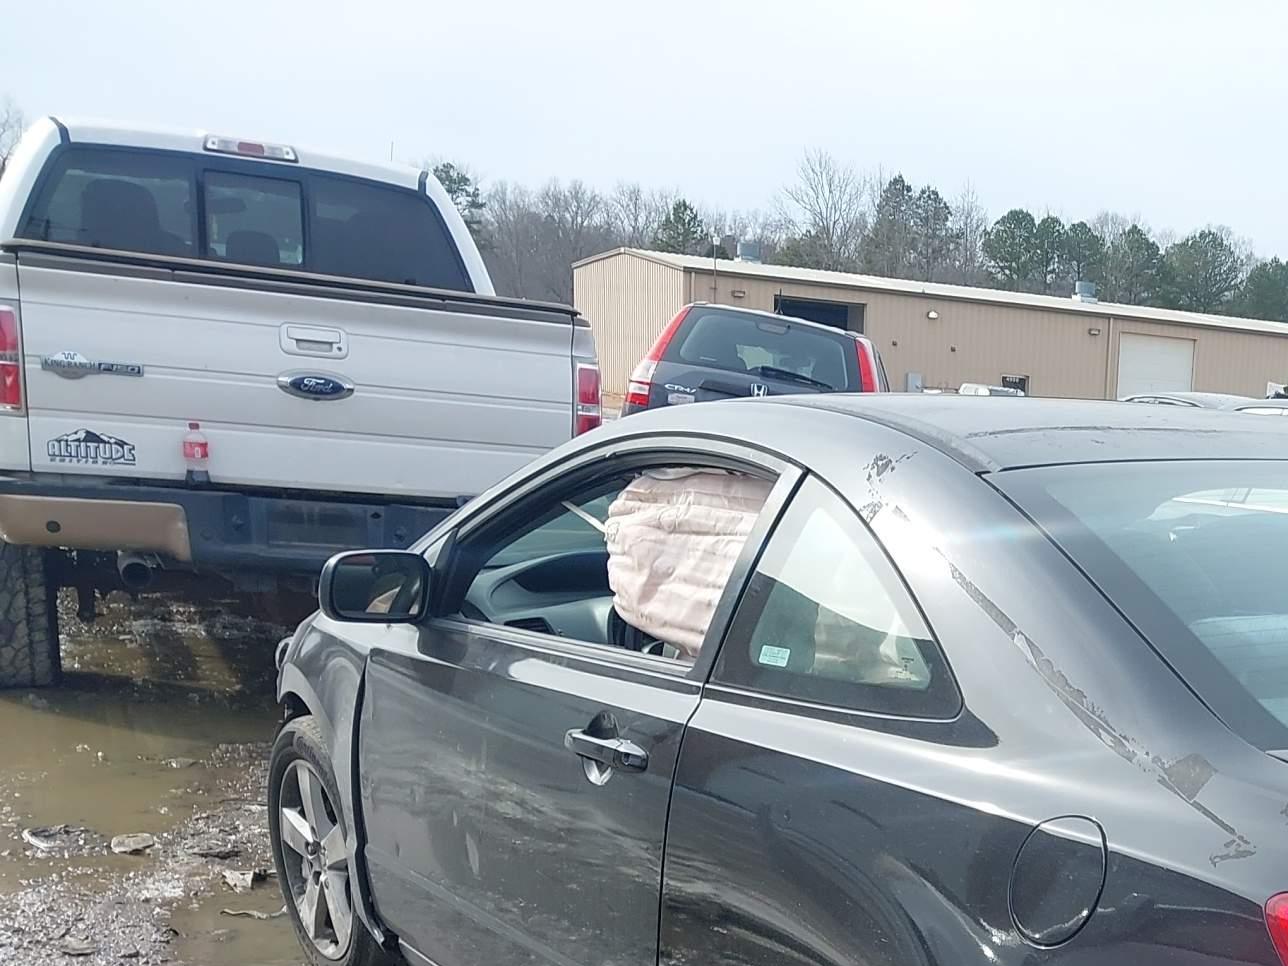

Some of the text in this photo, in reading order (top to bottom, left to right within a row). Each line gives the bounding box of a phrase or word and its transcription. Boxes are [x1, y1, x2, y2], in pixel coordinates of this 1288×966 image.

[44, 357, 96, 370] KING RANCH
[301, 378, 333, 393] Ford
[47, 440, 136, 462] ALTITUDE
